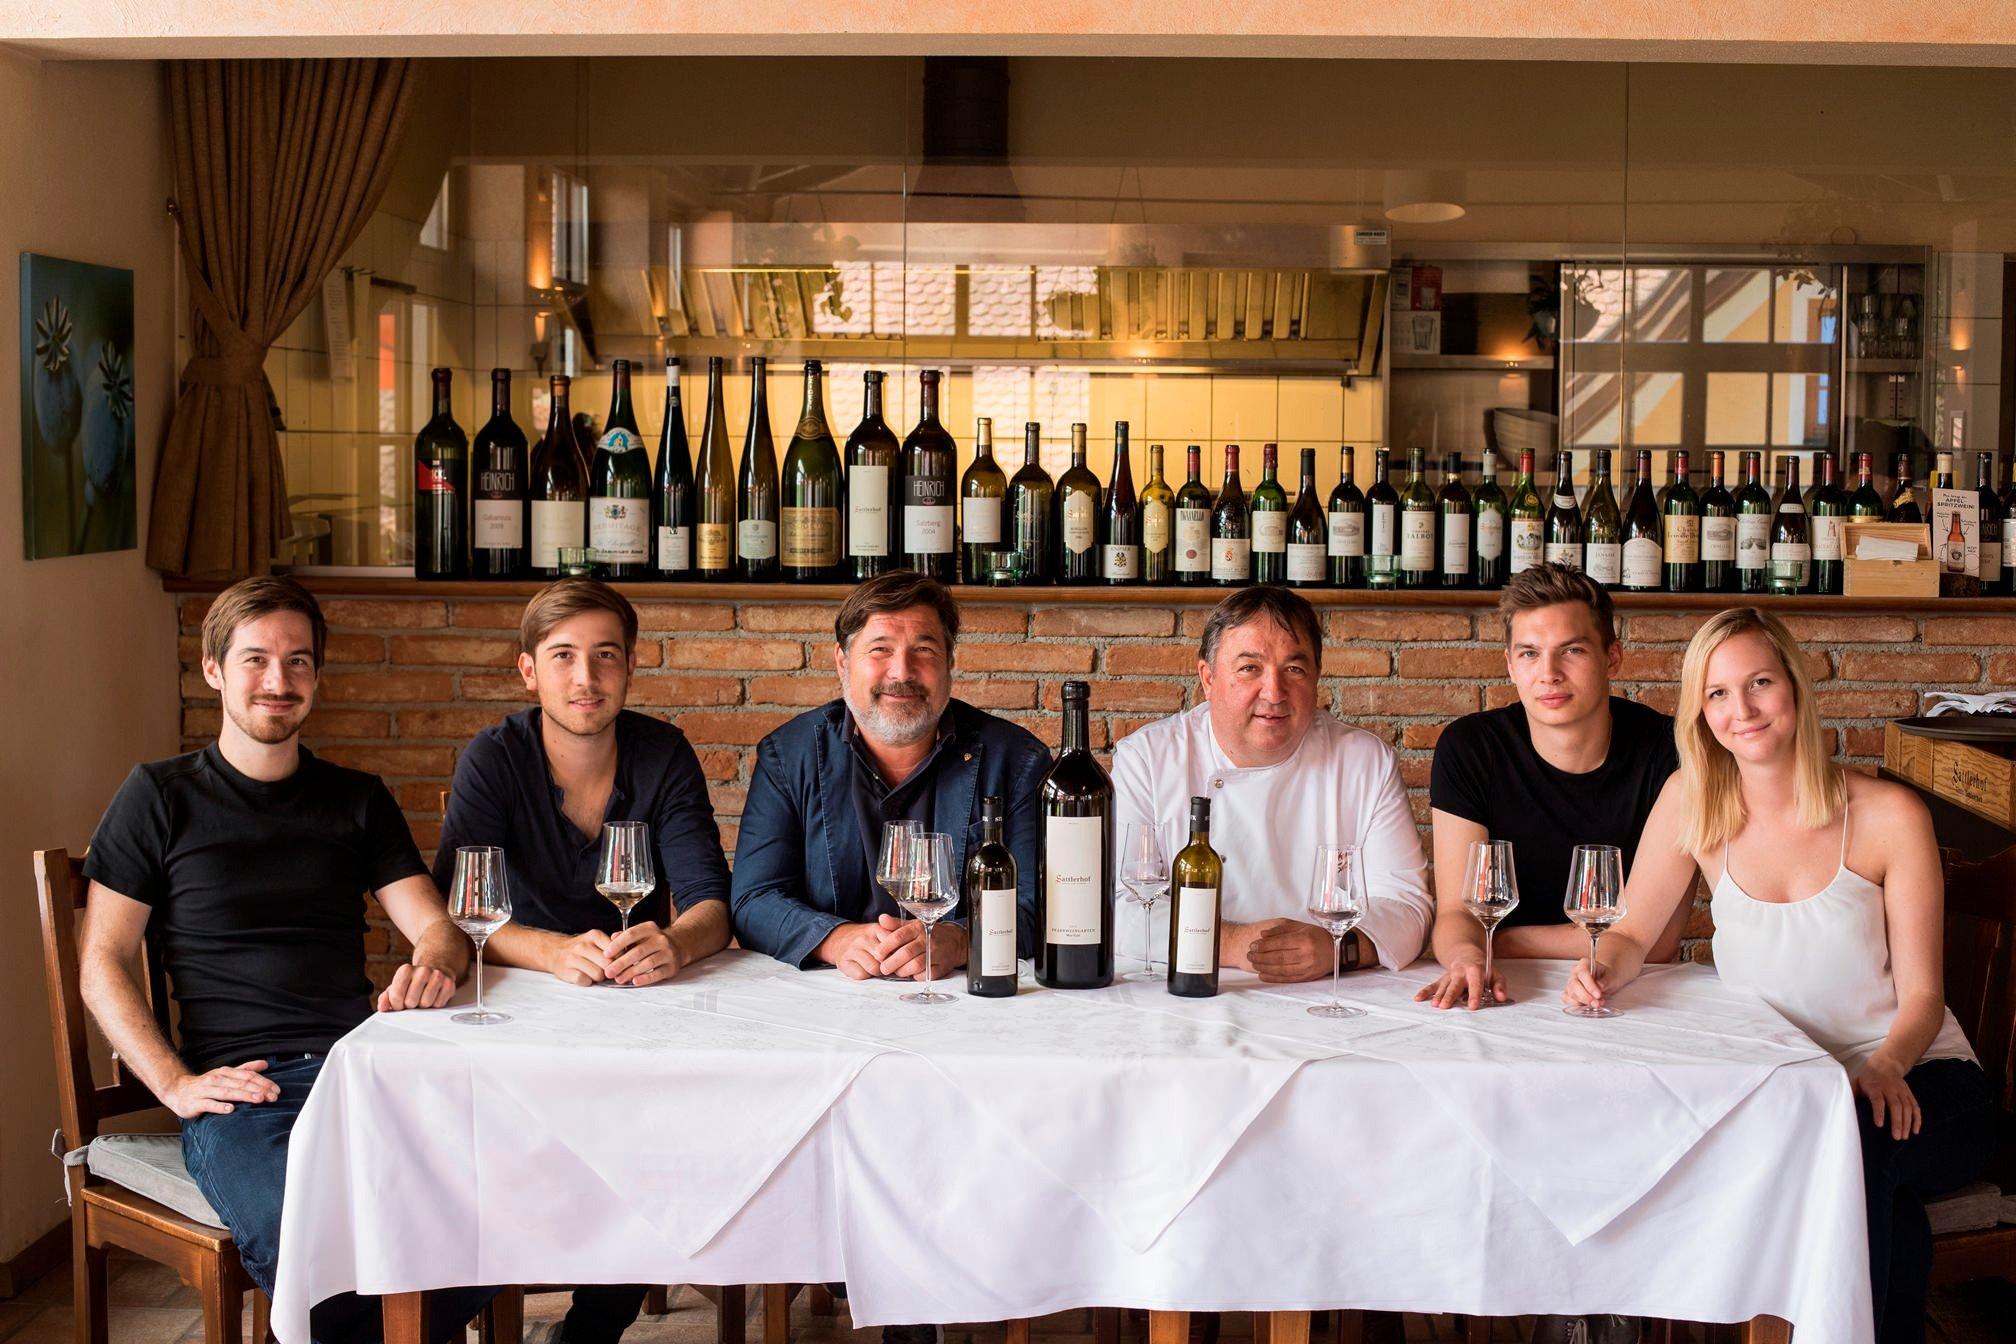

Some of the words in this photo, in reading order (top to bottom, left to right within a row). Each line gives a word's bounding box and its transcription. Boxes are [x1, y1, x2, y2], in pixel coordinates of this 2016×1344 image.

[481, 471, 515, 491] HEINRICH
[913, 480, 945, 497] HEINRICH
[1055, 874, 1091, 885] Sattlerhof
[988, 928, 1014, 936] Sattlerhof
[1183, 926, 1211, 934] Sattlerhof
